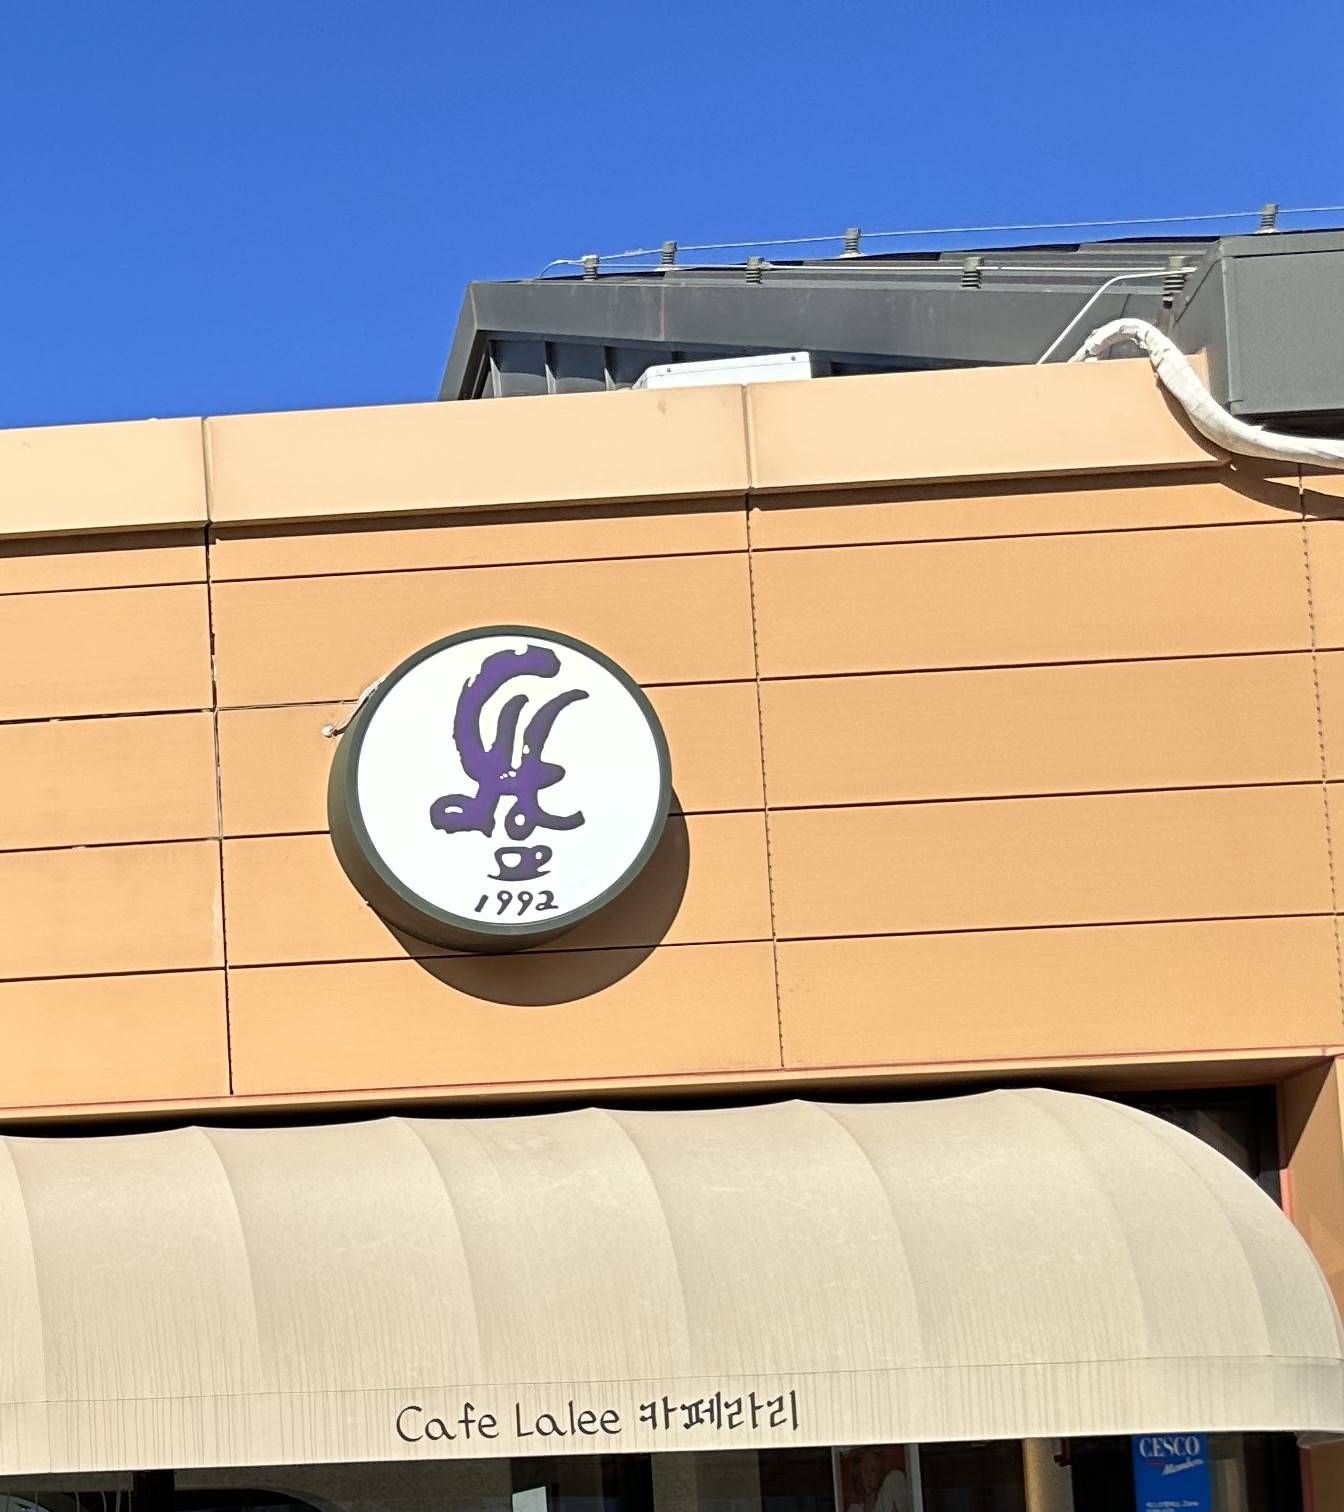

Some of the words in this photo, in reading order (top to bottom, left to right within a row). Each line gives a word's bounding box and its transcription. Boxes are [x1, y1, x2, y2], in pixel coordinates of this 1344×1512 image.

[474, 889, 560, 917] 1992
[395, 1401, 500, 1443] Cafe
[639, 1389, 800, 1431] 카페라리
[1138, 1436, 1201, 1458] CESCO
